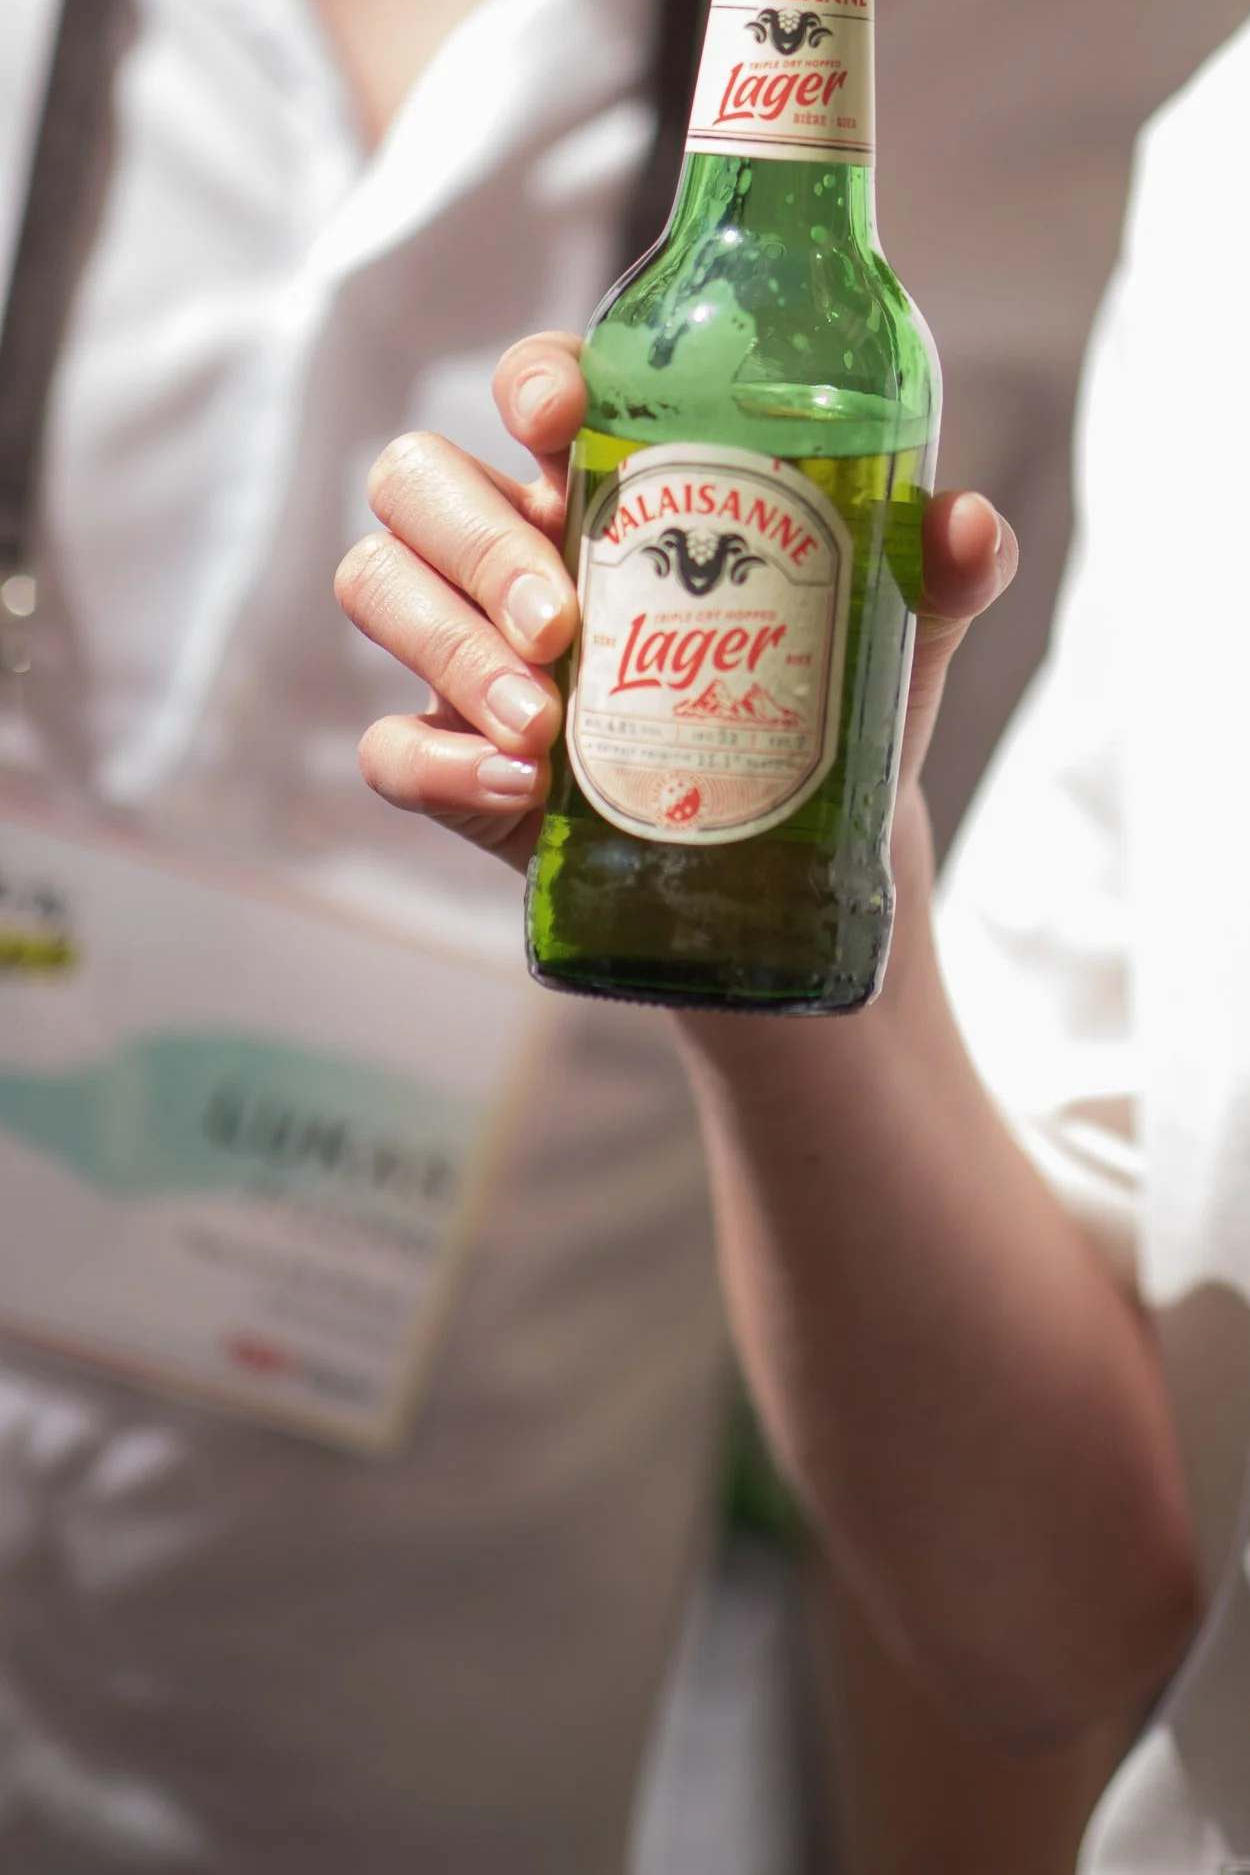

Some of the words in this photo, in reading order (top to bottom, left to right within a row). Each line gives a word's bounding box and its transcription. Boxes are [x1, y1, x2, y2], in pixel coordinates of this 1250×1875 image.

[712, 61, 848, 126] Lager
[750, 61, 779, 70] TRIPLE
[783, 60, 801, 70] DRY
[805, 60, 841, 69] HOPPED
[602, 483, 819, 567] VALAISANNE
[609, 613, 787, 696] Lager
